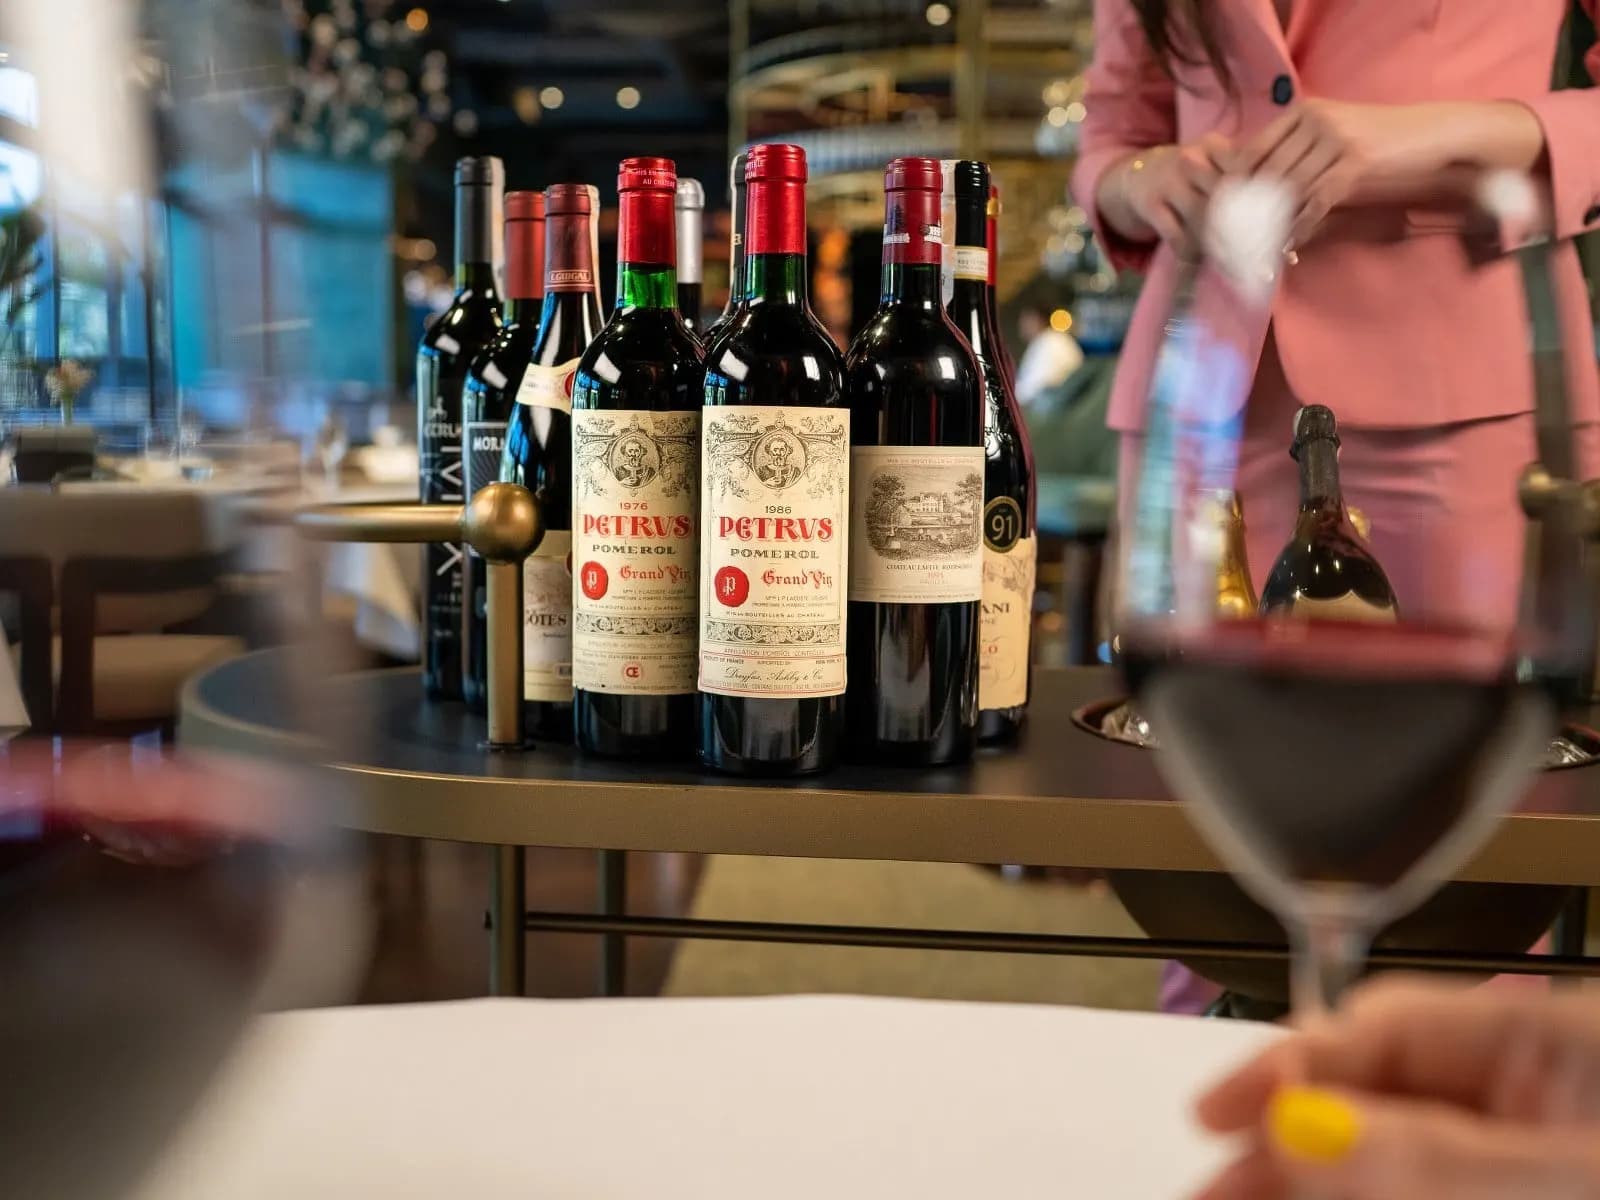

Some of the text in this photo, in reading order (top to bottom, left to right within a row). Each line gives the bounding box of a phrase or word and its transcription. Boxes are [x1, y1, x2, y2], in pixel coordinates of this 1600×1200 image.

[620, 502, 649, 511] 1976
[765, 505, 792, 514] 1986
[991, 514, 1014, 542] 91
[592, 544, 677, 555] POMEROL
[730, 548, 819, 559] POMEROL
[620, 564, 664, 580] Grand
[761, 568, 808, 586] Grand
